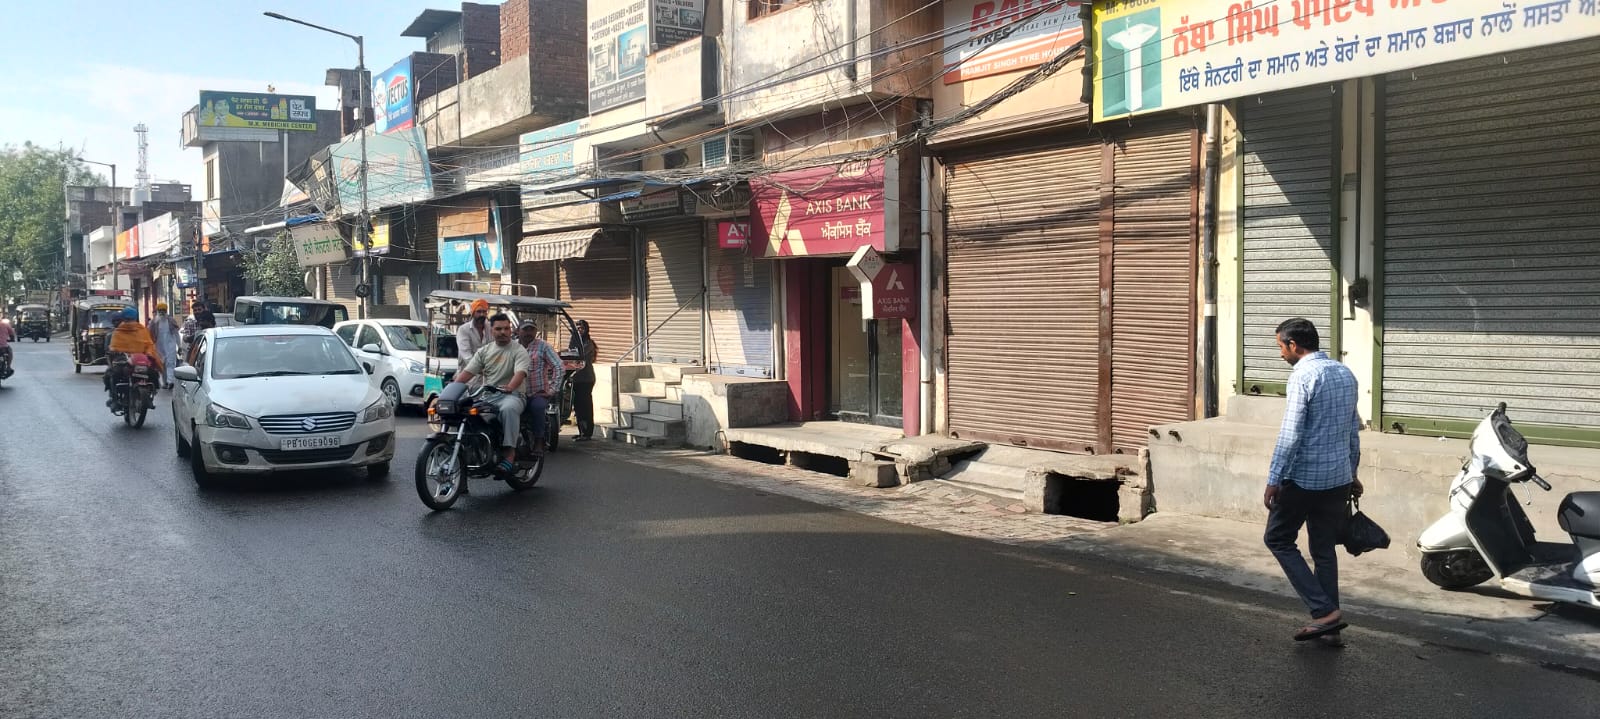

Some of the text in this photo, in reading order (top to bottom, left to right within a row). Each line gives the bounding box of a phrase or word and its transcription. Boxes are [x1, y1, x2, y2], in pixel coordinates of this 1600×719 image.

[1172, 15, 1215, 58] ਨੱਥਾ
[1225, 0, 1281, 47] ਸਿੰਘ
[960, 62, 991, 76] PRAMJIT
[993, 58, 1017, 69] SINGH
[1019, 53, 1040, 64] TYRE
[1179, 65, 1200, 93] ਇੱਥੇ
[1204, 57, 1244, 88] ਸੈਨਟਰੀ
[1248, 59, 1262, 79] ਦਾ
[1266, 52, 1301, 76] ਸਮਾਨ
[1305, 40, 1329, 67] ਅਤੇ
[1365, 36, 1382, 58] ਦਾ
[1387, 26, 1428, 53] ਸਮਾਨ
[388, 79, 409, 107] VECTUS
[805, 194, 872, 215] AXIS BANK
[821, 221, 853, 240] ਐਕਸਿਸ
[893, 296, 910, 304] BANK
